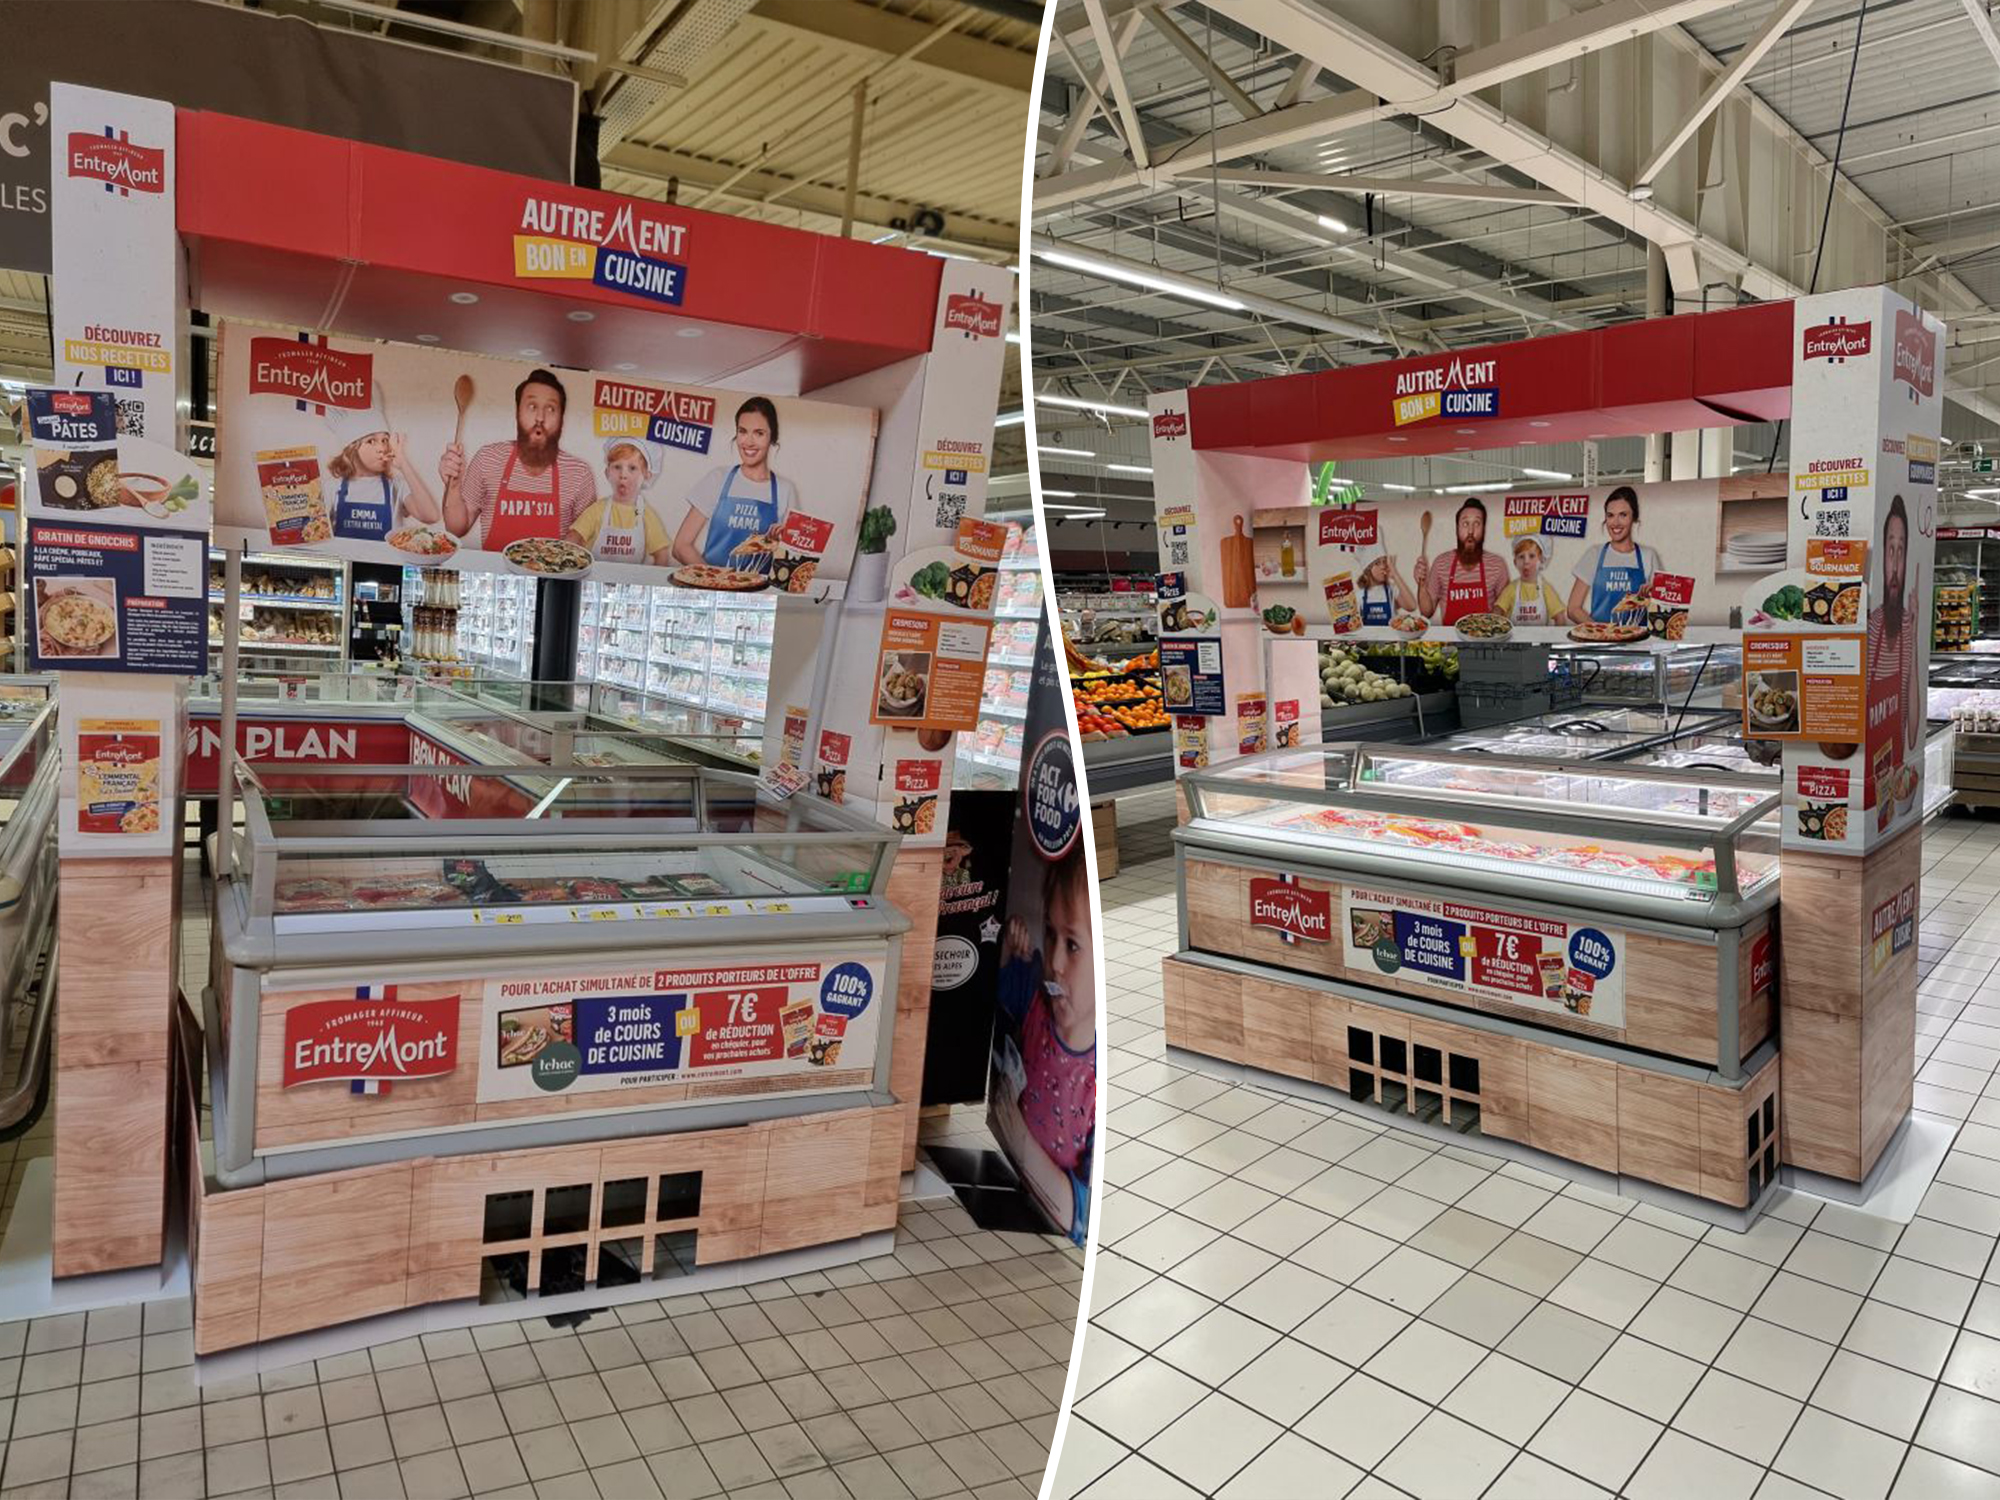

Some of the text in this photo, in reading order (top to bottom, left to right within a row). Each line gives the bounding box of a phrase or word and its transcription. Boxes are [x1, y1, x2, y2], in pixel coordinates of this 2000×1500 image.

[73, 153, 159, 187] EntreMont
[521, 198, 686, 258] AUTREMENT
[526, 244, 677, 297] BON EN CUISINE
[948, 309, 998, 332] EntreMont
[85, 324, 161, 348] DÉCOUVREZ
[1806, 334, 1867, 355] EntreMont
[70, 345, 167, 369] NOS RECETTES
[113, 368, 129, 383] ICI
[257, 363, 364, 403] EntreMont
[1396, 356, 1496, 394] AUTREMENT
[599, 384, 712, 423] AUTREMENT
[1401, 393, 1493, 420] BON EN CUISINE
[52, 418, 98, 438] PÂTES
[601, 412, 705, 449] BON EN CUISINE
[1809, 457, 1863, 473] DÉCOUVREZ
[1798, 471, 1866, 488] NOS RECETTES
[1826, 488, 1839, 499] ICI
[351, 509, 377, 520] EMMA
[500, 499, 555, 516] PAPA'STA
[735, 503, 758, 516] PIZZA
[1507, 496, 1587, 517] AUTREMENT
[728, 515, 761, 531] MAMA
[1321, 522, 1374, 543] EntreMont
[1509, 517, 1527, 532] BON
[1545, 517, 1582, 534] CUISINE
[37, 531, 135, 548] GRATIN DE GNOCCHIS
[606, 535, 632, 546] FILOU
[790, 533, 815, 549] PIZZA
[1610, 572, 1628, 580] PIZZA
[1809, 562, 1860, 573] GOURMANDE
[1606, 580, 1632, 592] MAMA
[1659, 591, 1682, 602] PIZZA
[245, 728, 357, 759] PLAN
[905, 779, 928, 790] PIZZA
[1040, 763, 1061, 787] ACT
[1037, 783, 1057, 808] FOR
[1809, 785, 1837, 797] PIZZA
[1034, 801, 1062, 830] FOOD
[1255, 900, 1325, 934] EntreMont
[1351, 889, 1368, 900] POUR
[1368, 890, 1394, 904] L'ACHAT
[1396, 896, 1431, 911] SIMULTANÉ
[1433, 903, 1442, 913] DE
[1450, 907, 1484, 921] PRODUITS
[1486, 913, 1523, 929] PORTEURS
[1524, 918, 1533, 930] DE
[1534, 921, 1564, 936] L'OFFRE
[1414, 921, 1443, 938] 3 mois
[1407, 935, 1450, 954] de COURS
[1495, 933, 1519, 960] 7€
[1580, 936, 1610, 962] 100%
[1404, 949, 1454, 970] DE CUISINE
[1481, 957, 1534, 975] de RÉDUCTION
[1574, 952, 1608, 971] GAGNANT
[501, 967, 817, 997] POUR L'ACHAT SIMULTANÉ DE 2 PRODUITS PORTEURS DE L'OFFRE
[832, 973, 867, 997] 100%
[727, 993, 758, 1024] 7€
[826, 992, 864, 1007] GAGNANT
[326, 1008, 424, 1029] FROMAGER AFFINEUR
[607, 1004, 652, 1022] 3 mois
[681, 1014, 696, 1029] OU
[595, 1023, 661, 1044] de COURS
[706, 1024, 774, 1041] de RÉDUCTION
[295, 1024, 447, 1073] EntreMont
[588, 1042, 665, 1064] DE CUISINE
[620, 1076, 638, 1085] POUR
[639, 1074, 676, 1085] PARTICIPER
